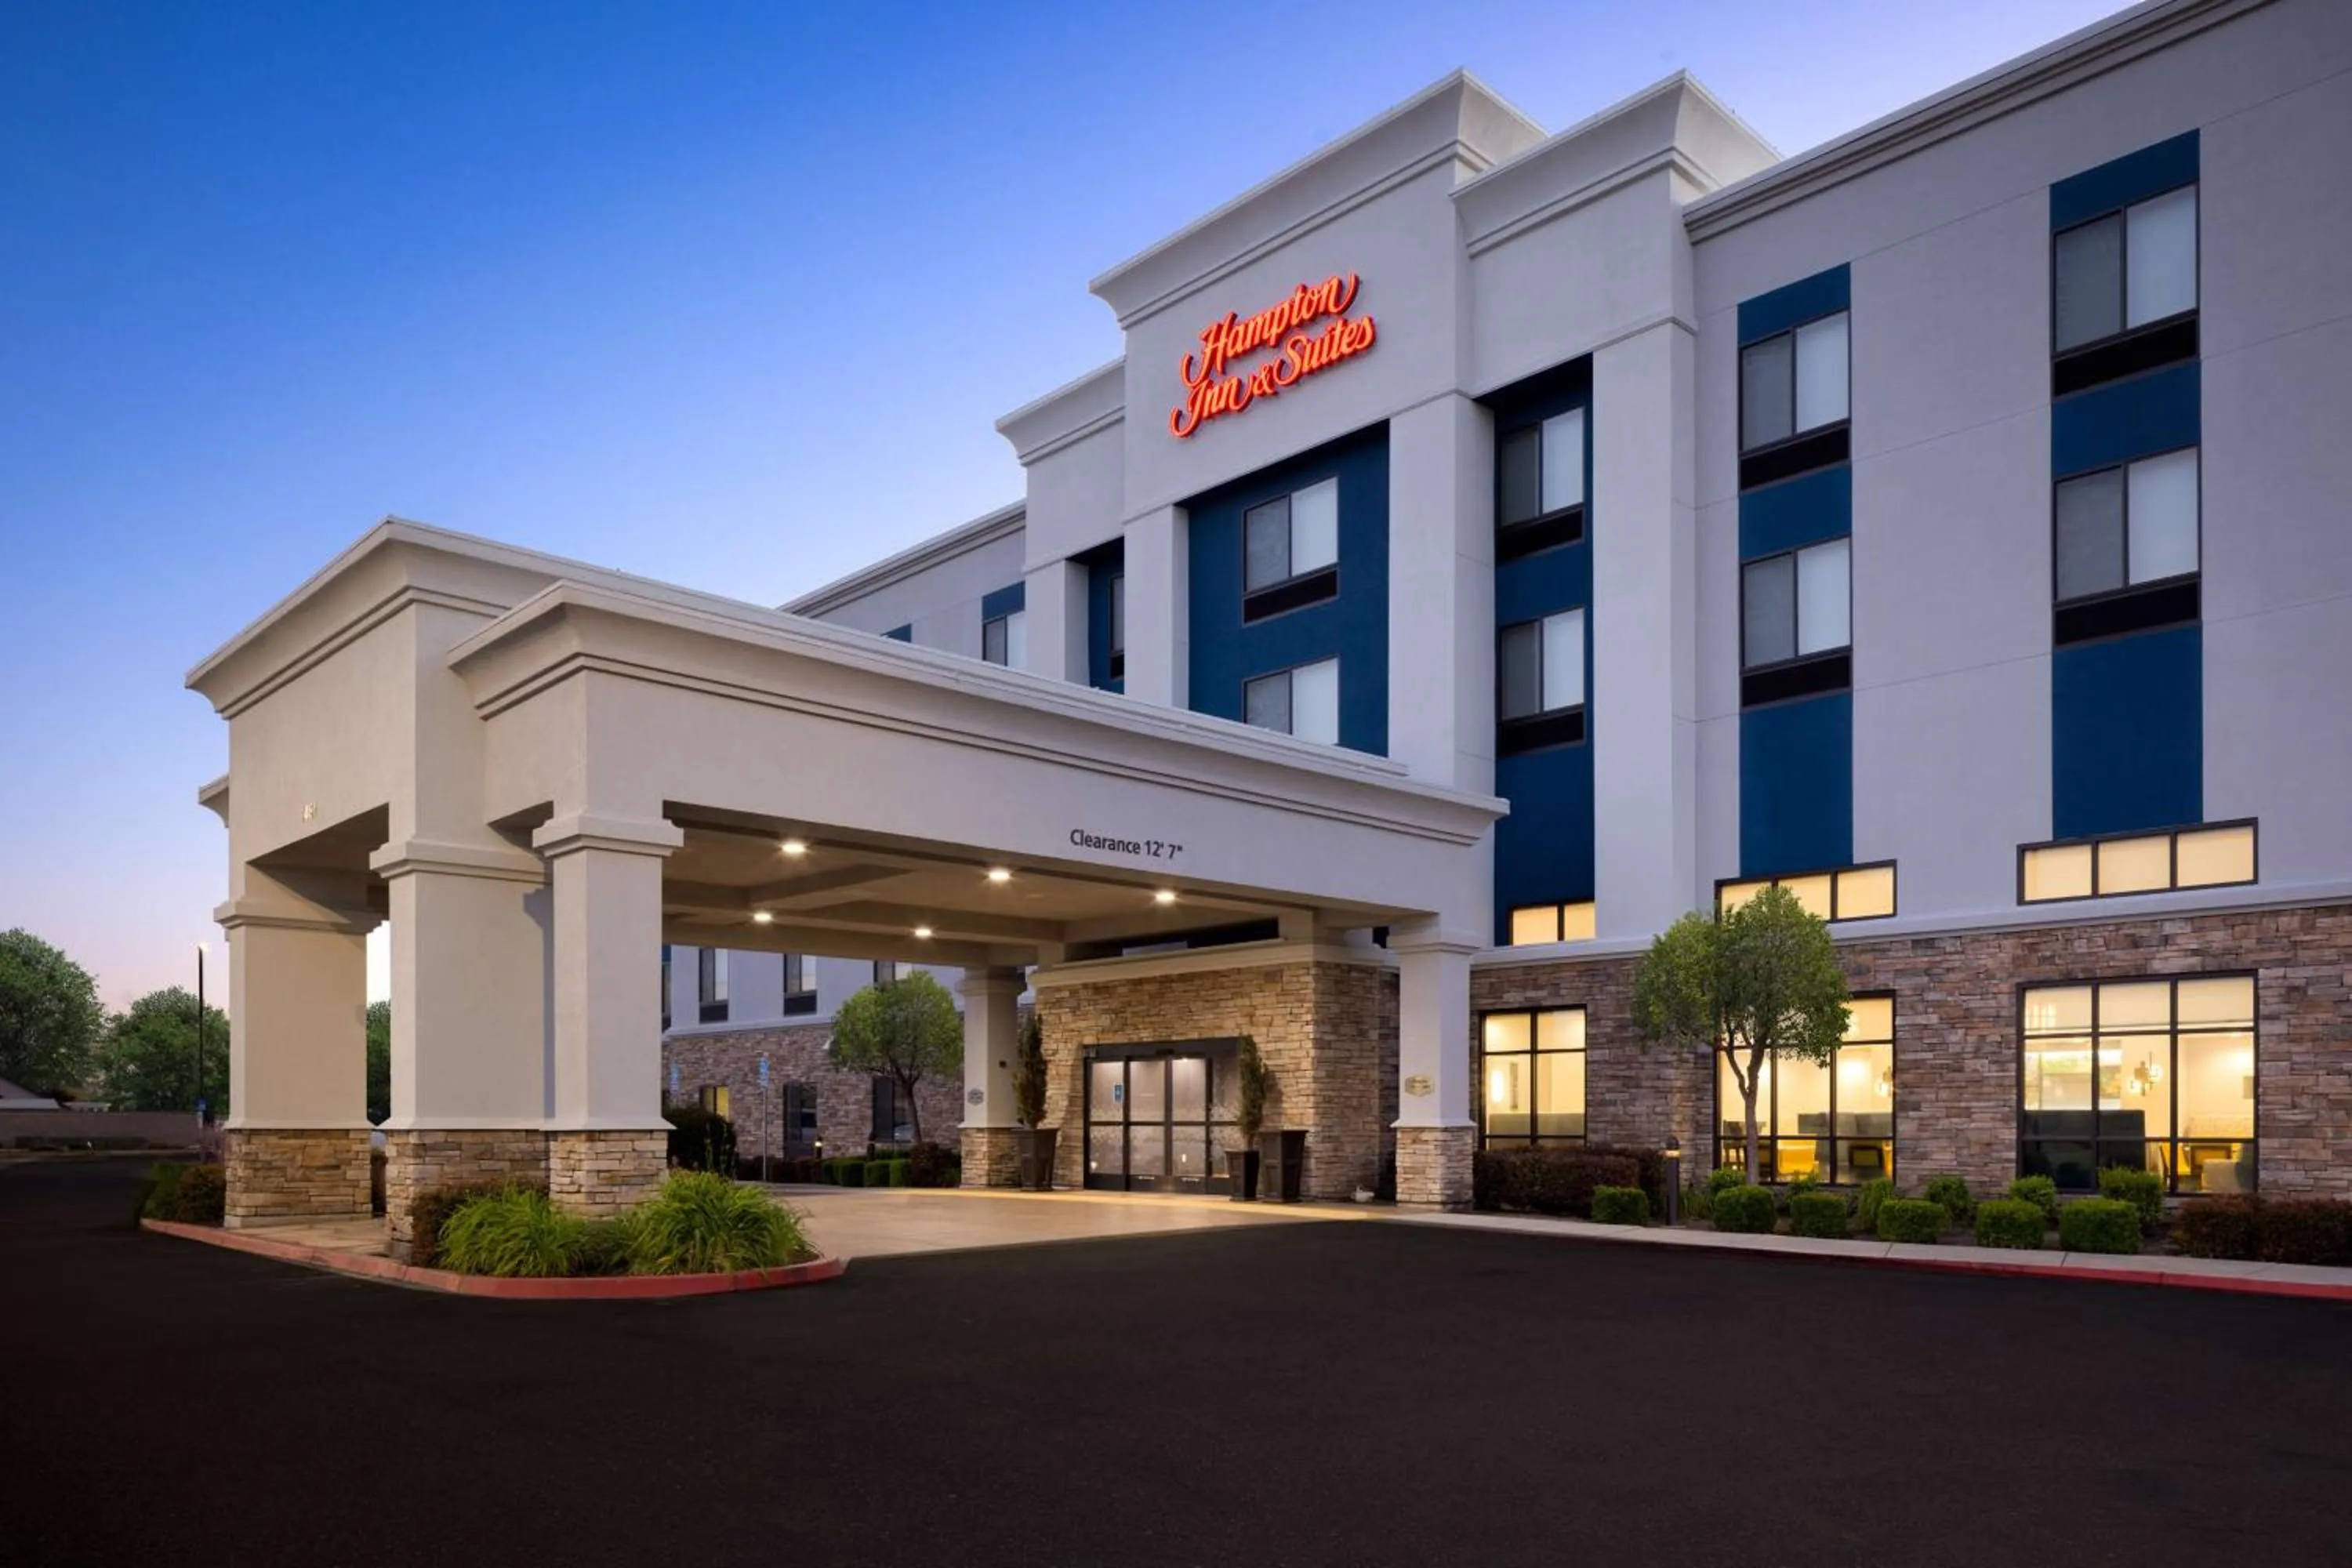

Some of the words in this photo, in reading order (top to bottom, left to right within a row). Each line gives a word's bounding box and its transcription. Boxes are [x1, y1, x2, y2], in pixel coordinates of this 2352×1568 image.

[1171, 374, 1256, 437] Inn
[1252, 363, 1278, 397] &
[1273, 315, 1377, 385] Suites
[1181, 272, 1360, 387] Hampton
[1069, 829, 1142, 855] Clearance
